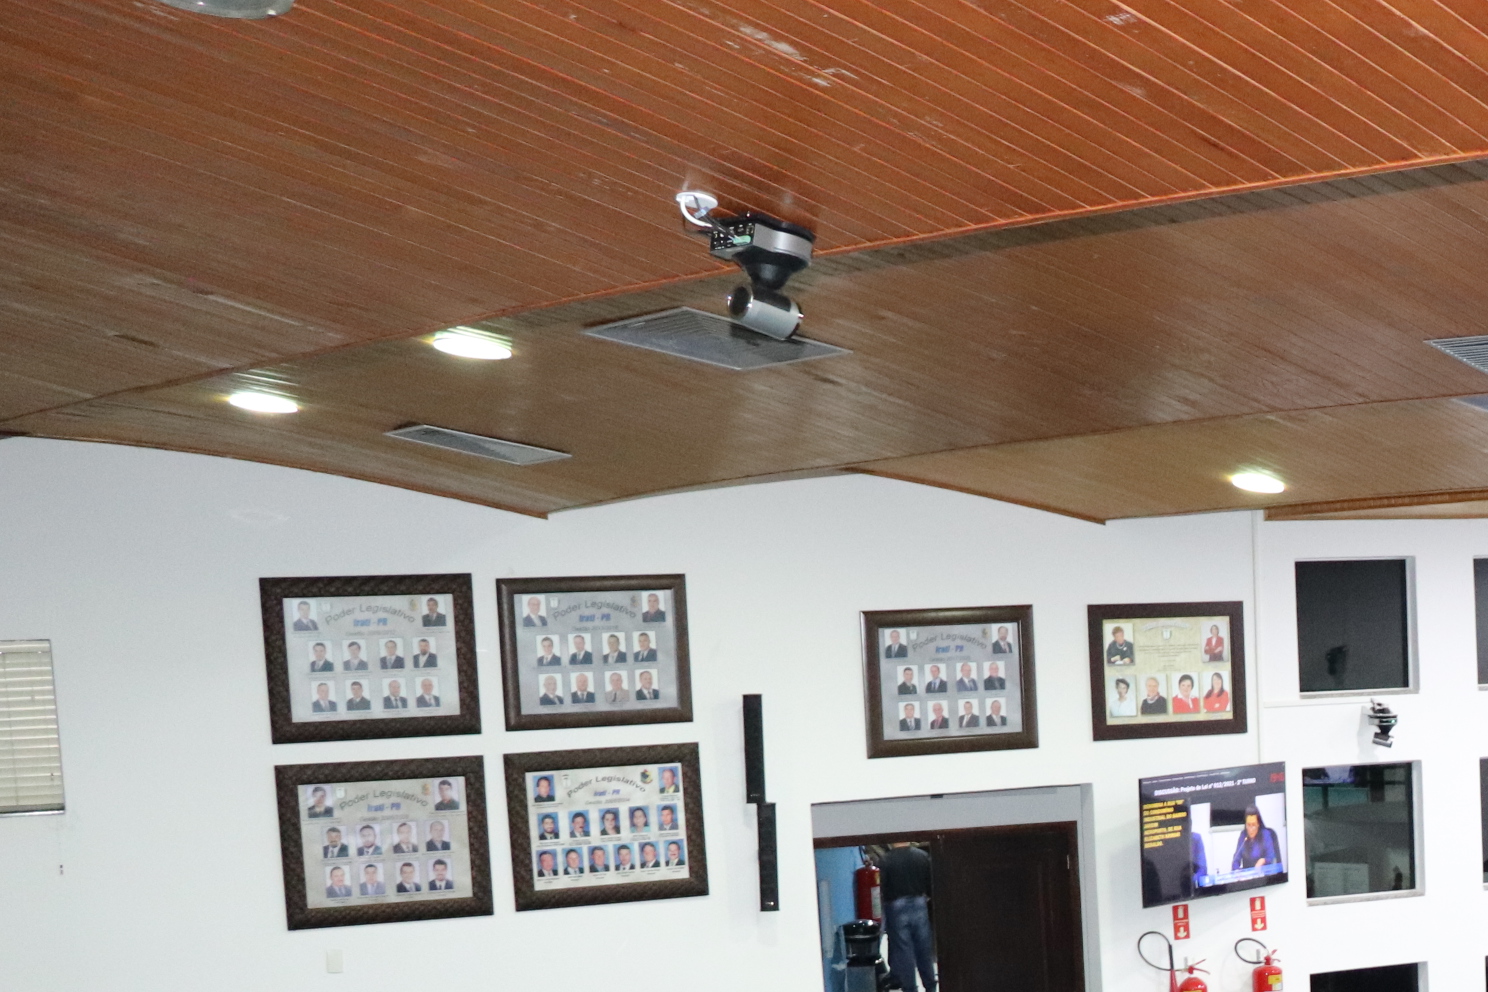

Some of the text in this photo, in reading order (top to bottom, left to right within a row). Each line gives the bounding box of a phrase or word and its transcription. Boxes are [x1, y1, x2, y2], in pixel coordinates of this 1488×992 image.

[324, 603, 416, 625] Poder Legislativo
[551, 599, 637, 621] Poder Legislativo
[912, 632, 987, 652] Poder Legislativo
[566, 774, 646, 798] Poder Legislativo
[338, 789, 429, 811] Poder Legislativo
